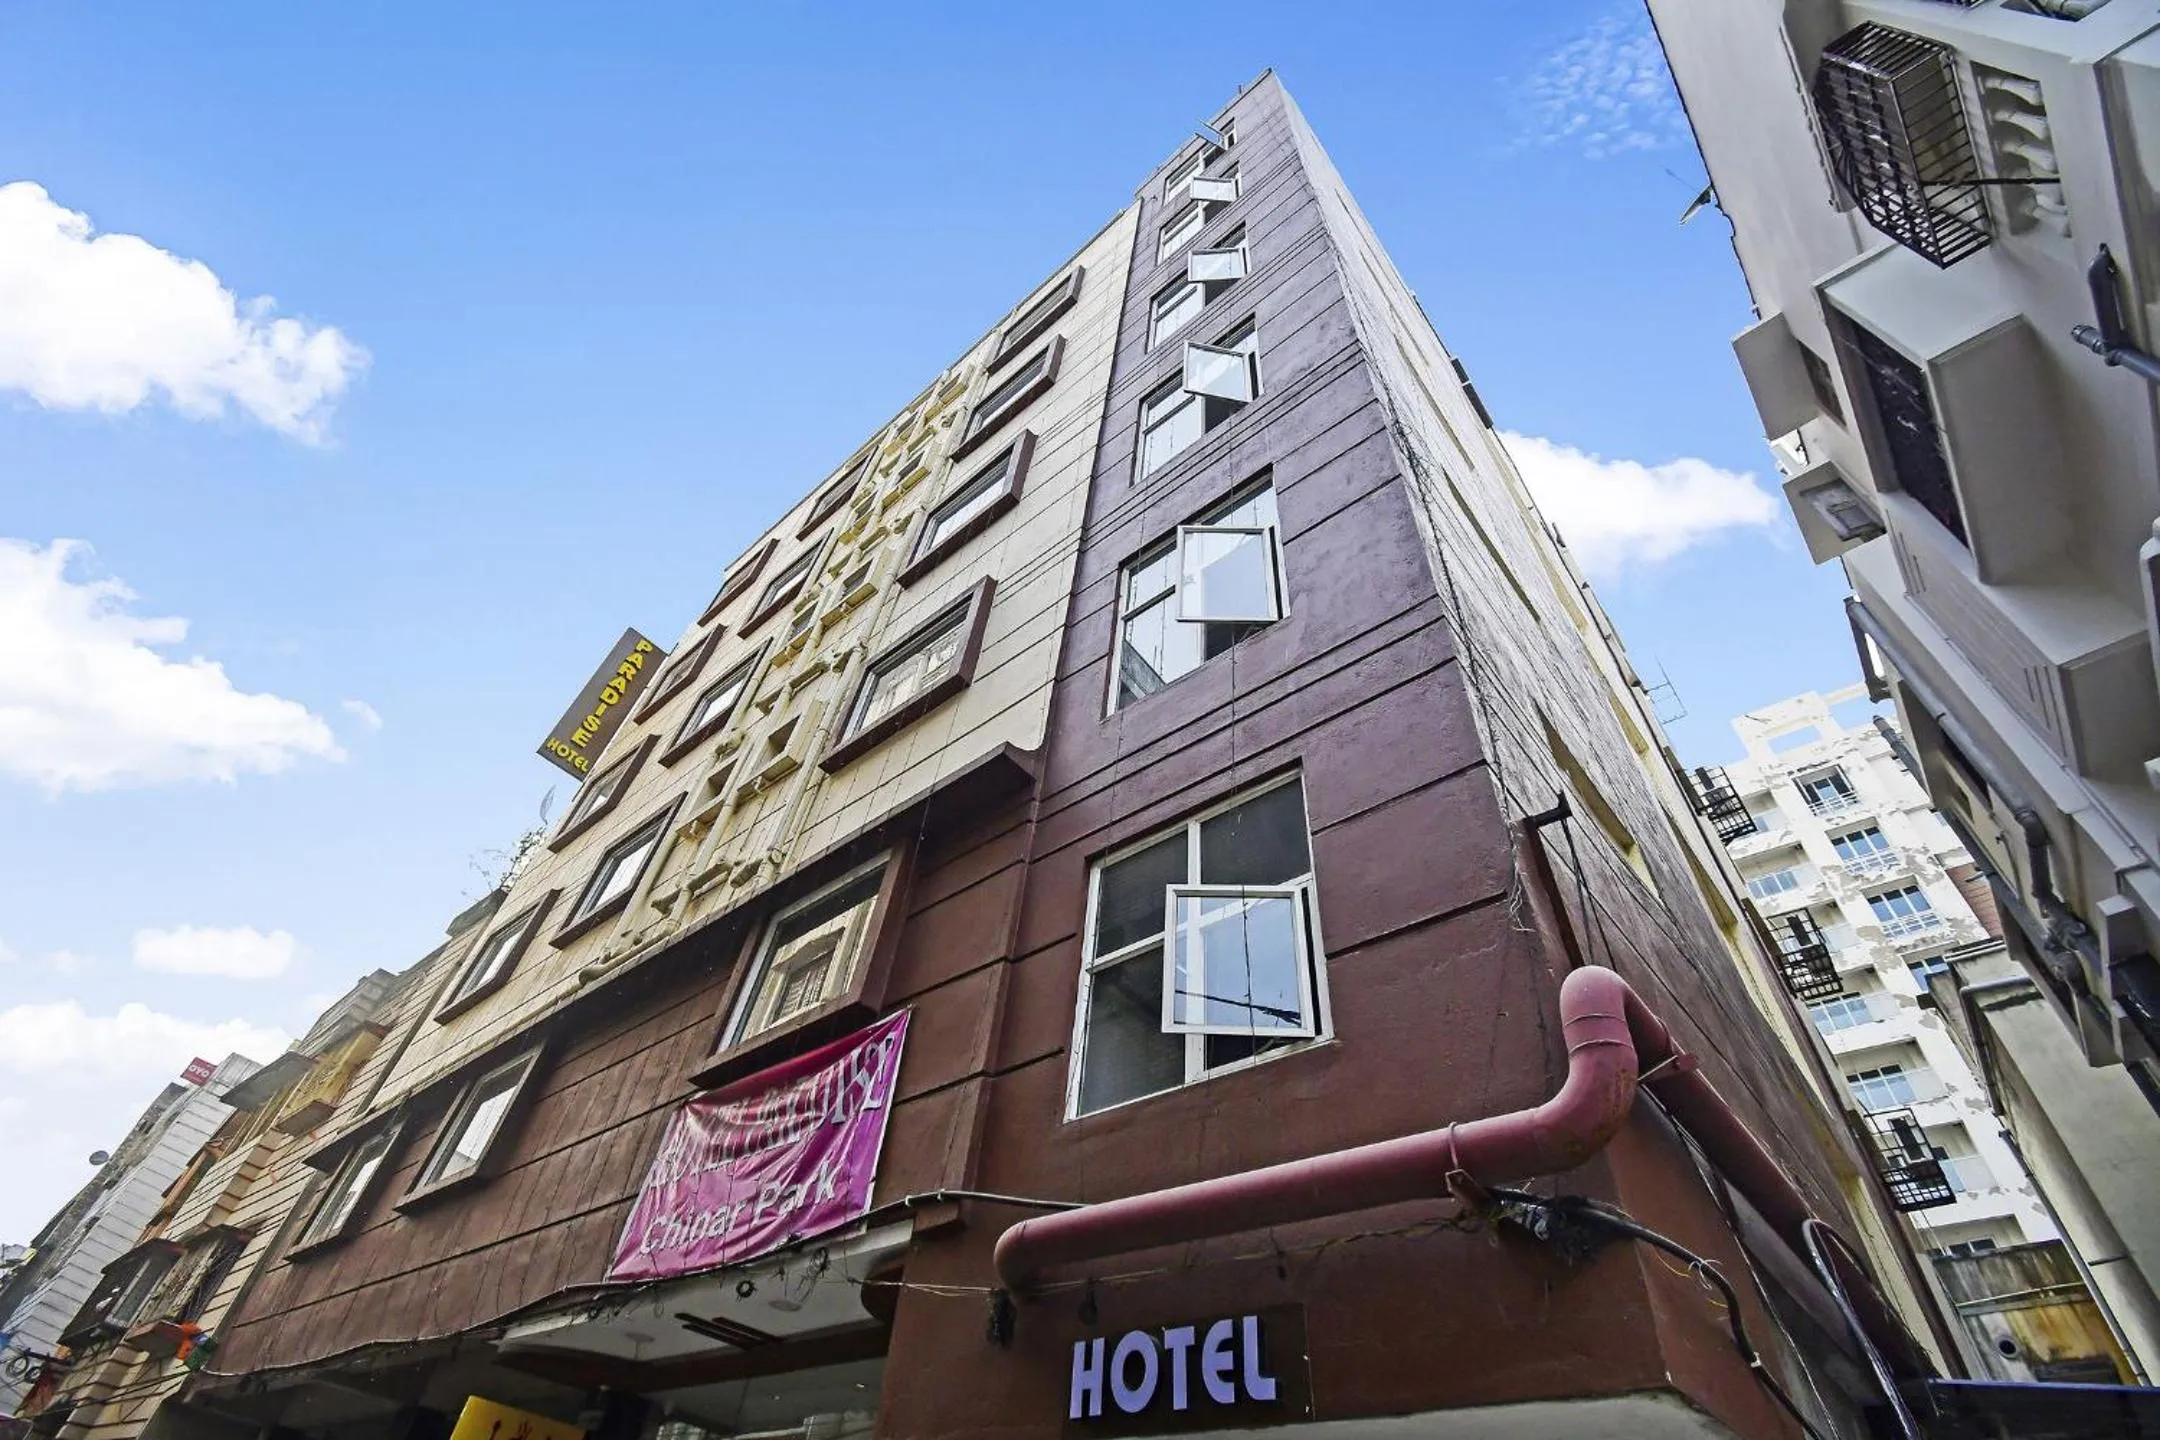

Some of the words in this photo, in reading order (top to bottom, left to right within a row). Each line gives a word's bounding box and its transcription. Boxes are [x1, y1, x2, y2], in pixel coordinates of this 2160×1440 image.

[571, 640, 653, 747] PARADISE
[547, 738, 589, 772] HOTEL
[189, 1065, 209, 1077] OYO
[643, 1202, 747, 1253] Chinar
[753, 1161, 835, 1227] Park
[1069, 1316, 1276, 1419] HOTEL
